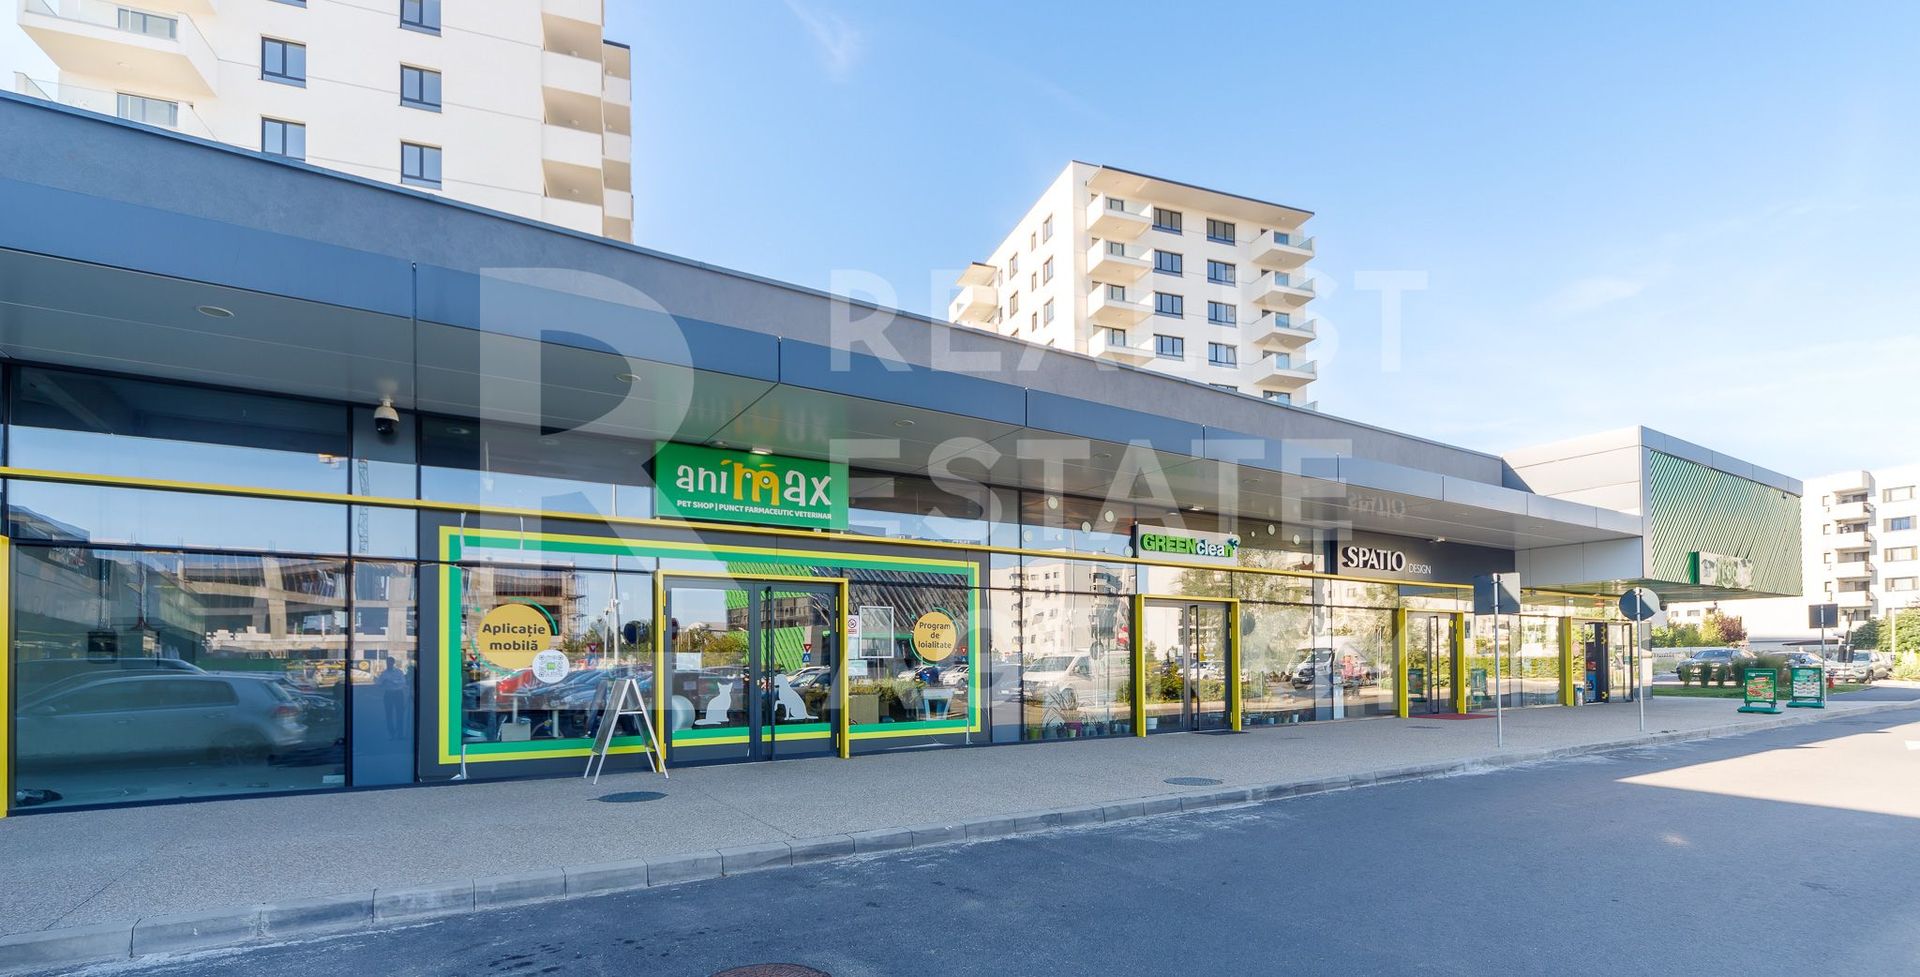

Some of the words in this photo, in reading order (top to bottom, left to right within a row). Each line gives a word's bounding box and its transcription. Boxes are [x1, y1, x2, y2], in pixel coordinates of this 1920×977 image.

[676, 500, 691, 508] PET
[693, 501, 714, 510] SHOP
[719, 503, 745, 512] PUNCT
[745, 506, 794, 517] FARMACEUTIC
[795, 510, 832, 520] VETERINAR
[1346, 546, 1406, 571] SPATIO
[1408, 563, 1432, 574] DESIGN
[482, 623, 546, 637] Aplicație
[919, 621, 951, 632] Program
[489, 640, 538, 650] mobilă
[918, 641, 952, 649] loialitate
